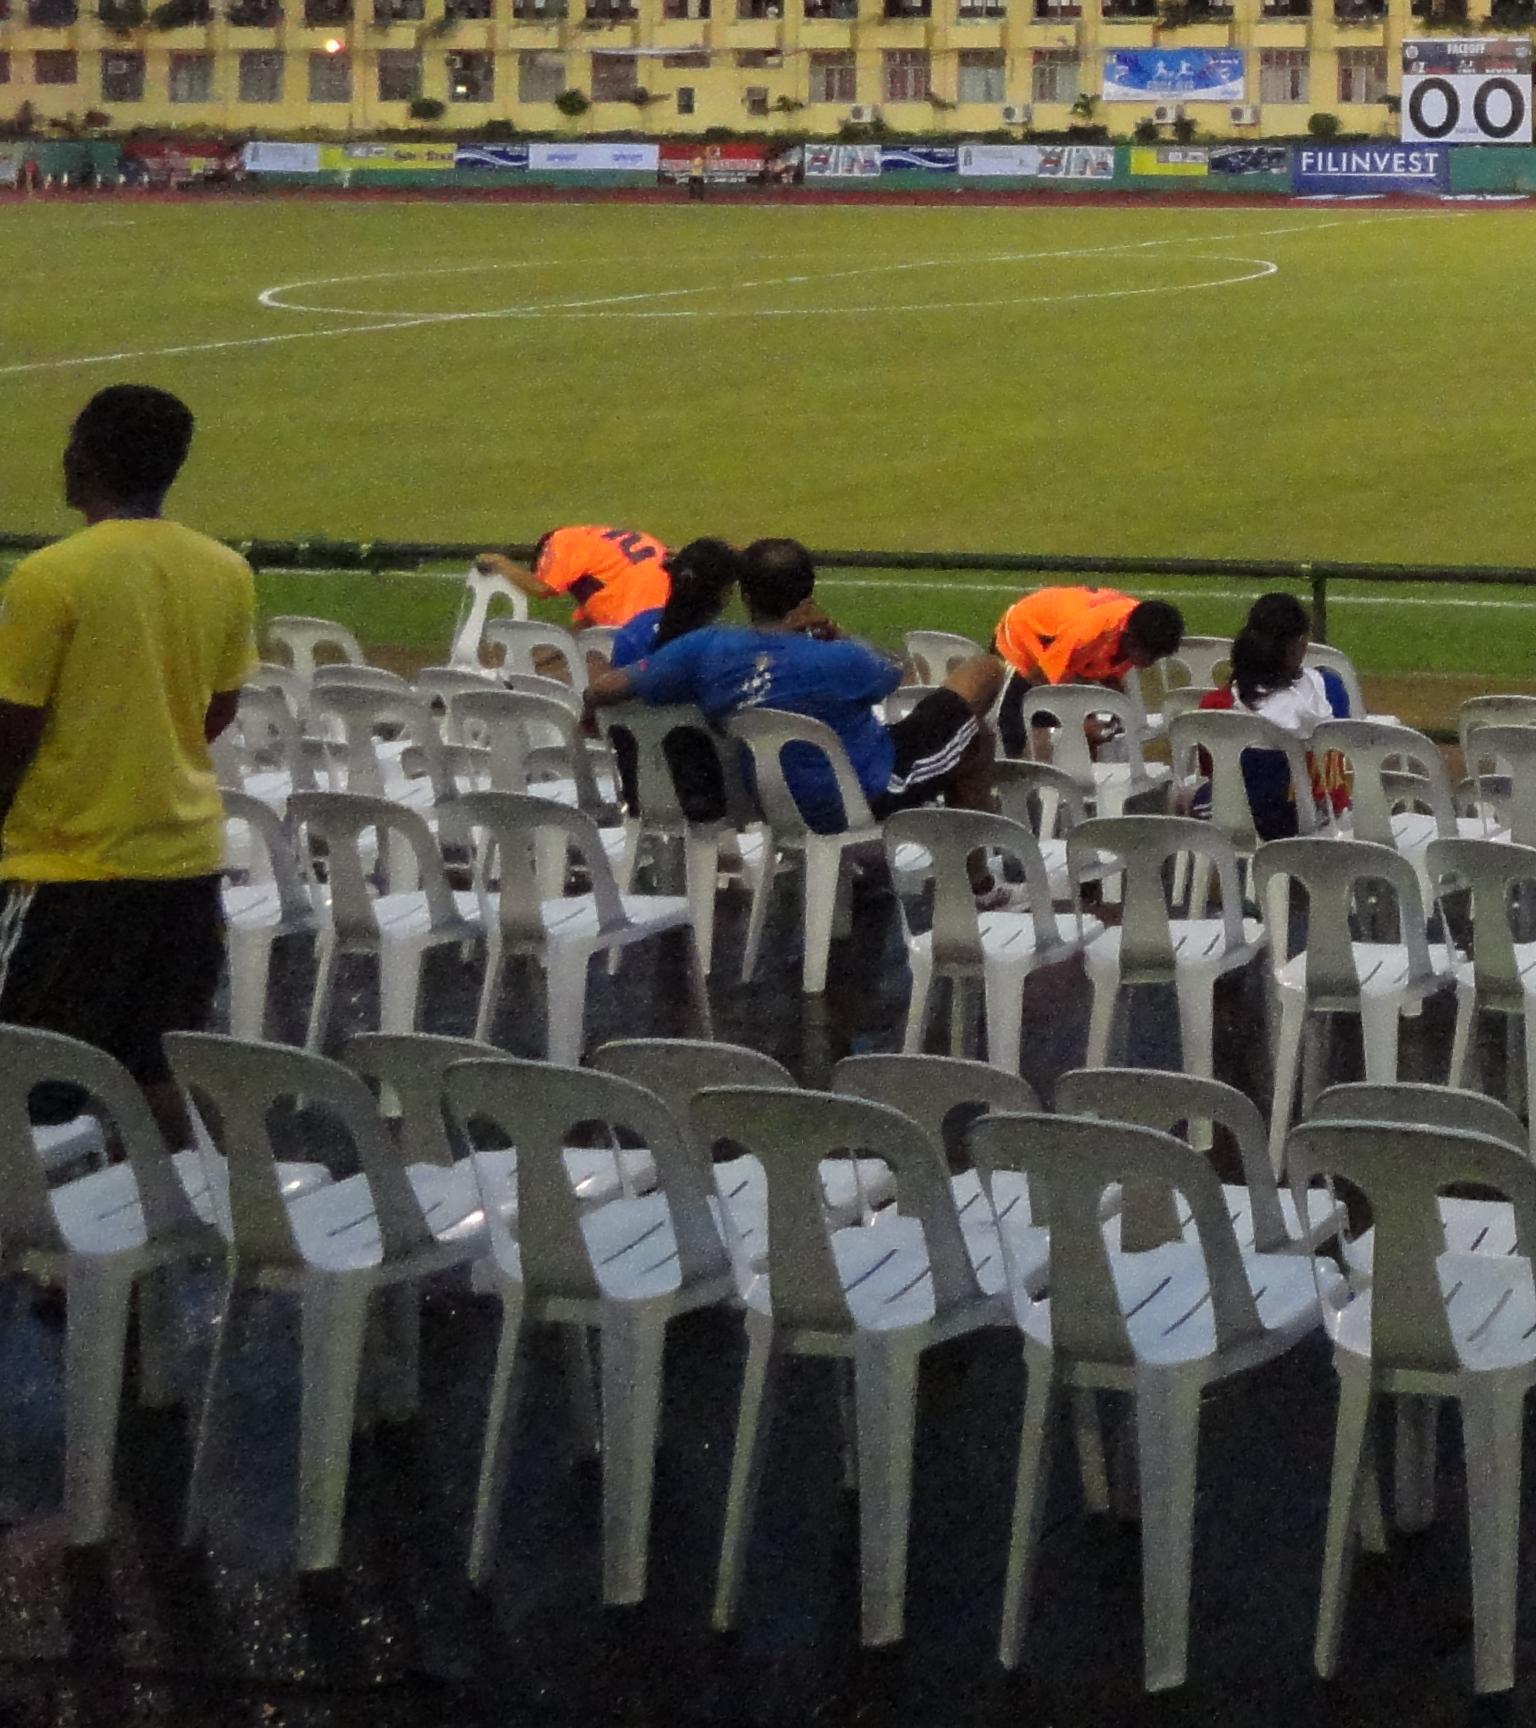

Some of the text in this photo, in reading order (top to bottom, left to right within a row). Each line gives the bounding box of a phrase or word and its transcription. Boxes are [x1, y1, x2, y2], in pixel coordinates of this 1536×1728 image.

[1447, 43, 1486, 55] FACEOFF
[1409, 77, 1526, 139] 0 0
[1301, 151, 1439, 173] FILINVEST
